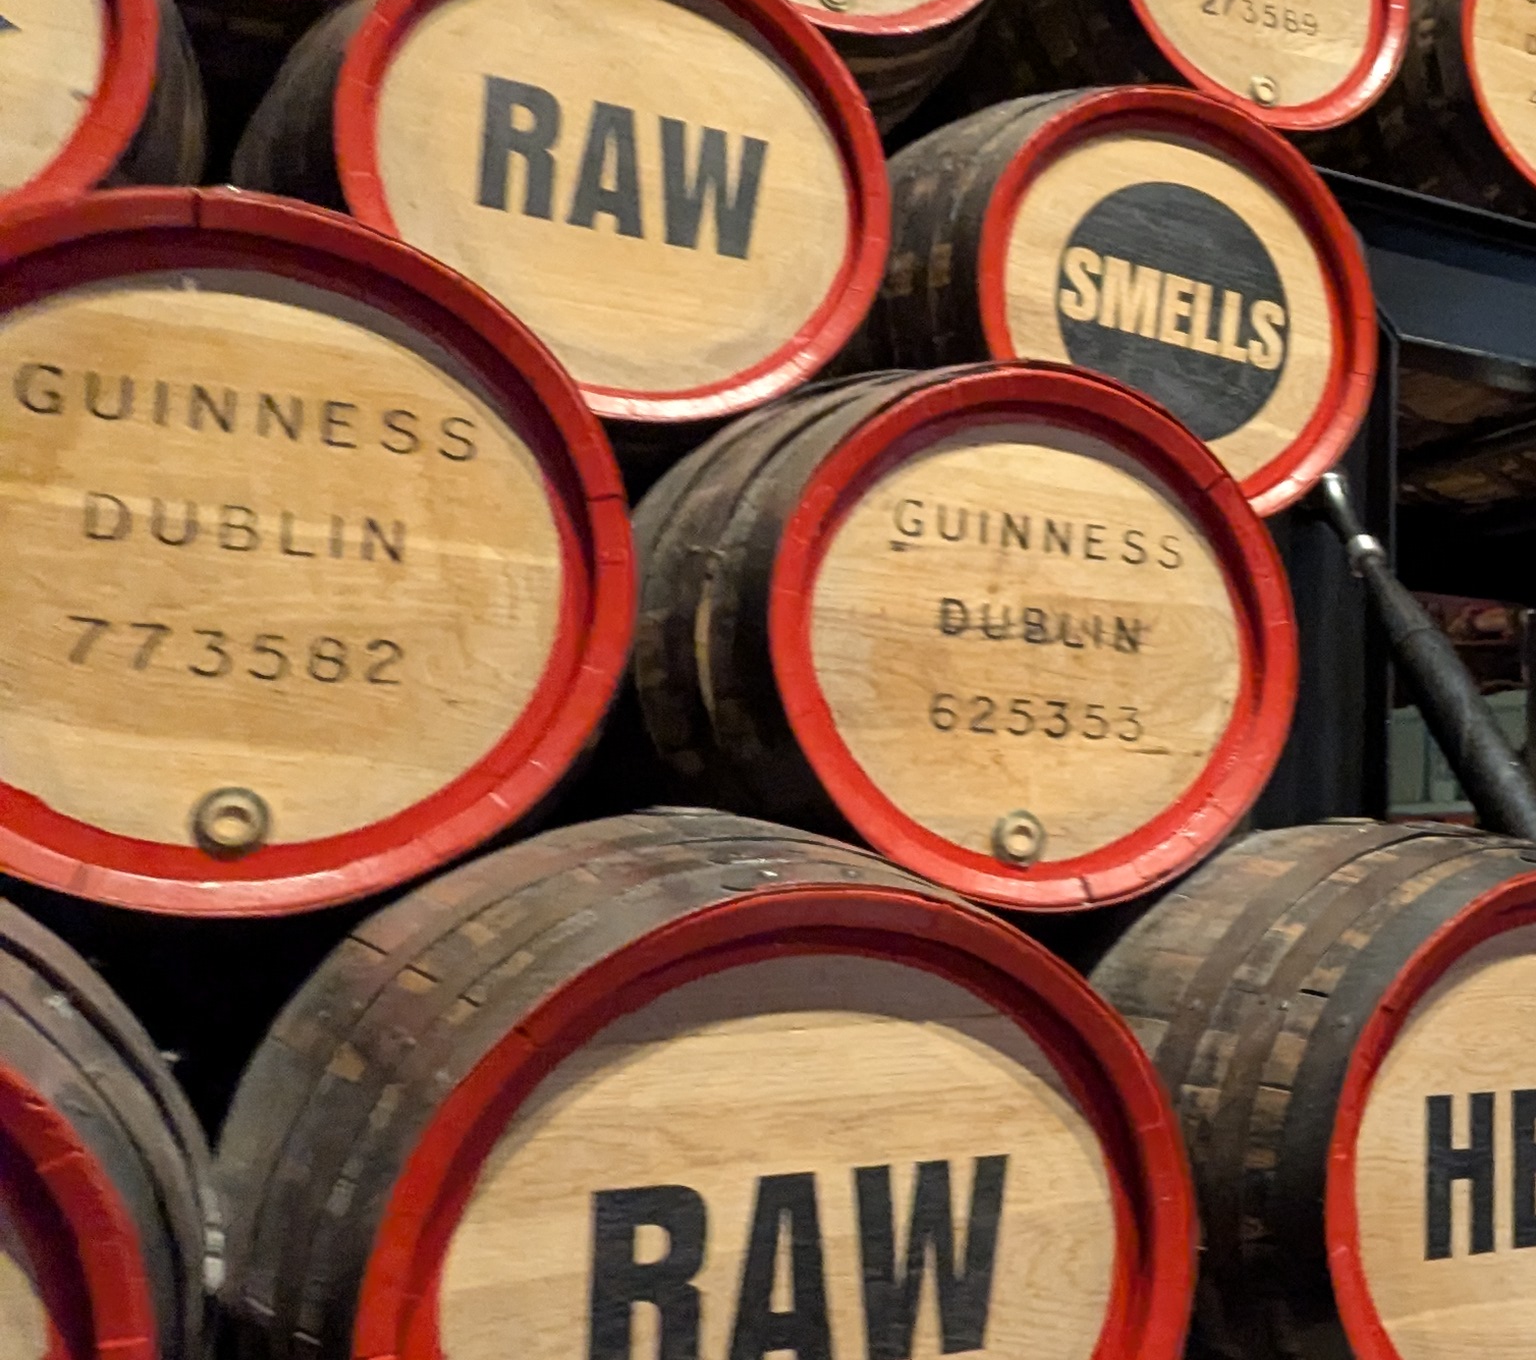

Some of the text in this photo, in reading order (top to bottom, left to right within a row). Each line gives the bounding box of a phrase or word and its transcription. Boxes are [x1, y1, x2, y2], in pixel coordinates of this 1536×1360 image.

[476, 74, 770, 260] RAW
[1058, 246, 1287, 371] SMELLS
[13, 362, 480, 462] GUINNESS
[82, 492, 409, 564] DUBLIN
[893, 498, 1184, 570] GUINNESS
[66, 615, 406, 685] 773582
[939, 596, 1143, 654] DUBLIN
[929, 693, 1144, 742] 625353
